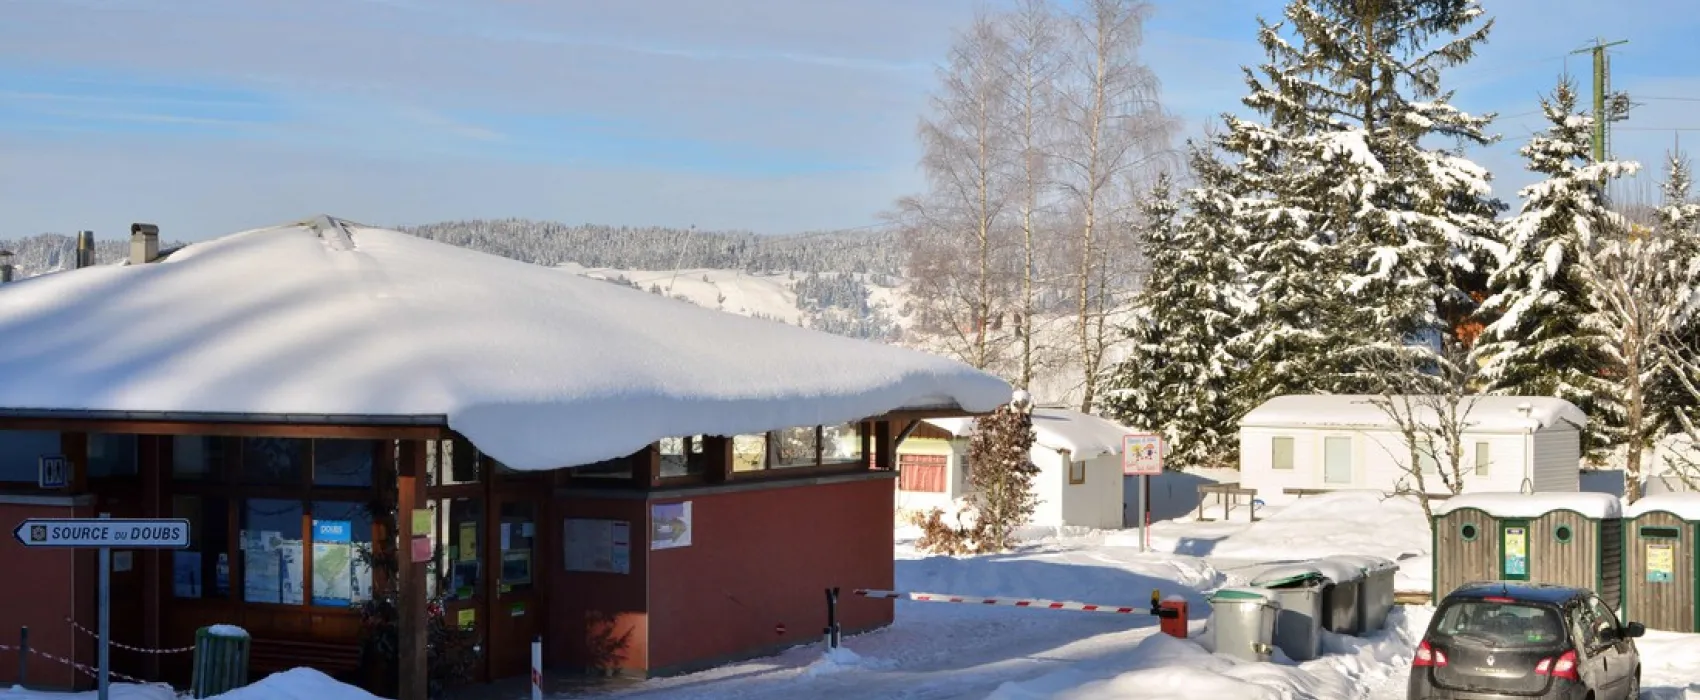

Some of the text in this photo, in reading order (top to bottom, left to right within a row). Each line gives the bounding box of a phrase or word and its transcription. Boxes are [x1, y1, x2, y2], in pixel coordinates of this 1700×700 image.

[52, 527, 109, 540] SOURCE
[130, 527, 180, 540] DOUBS
[320, 525, 343, 534] DOUBS
